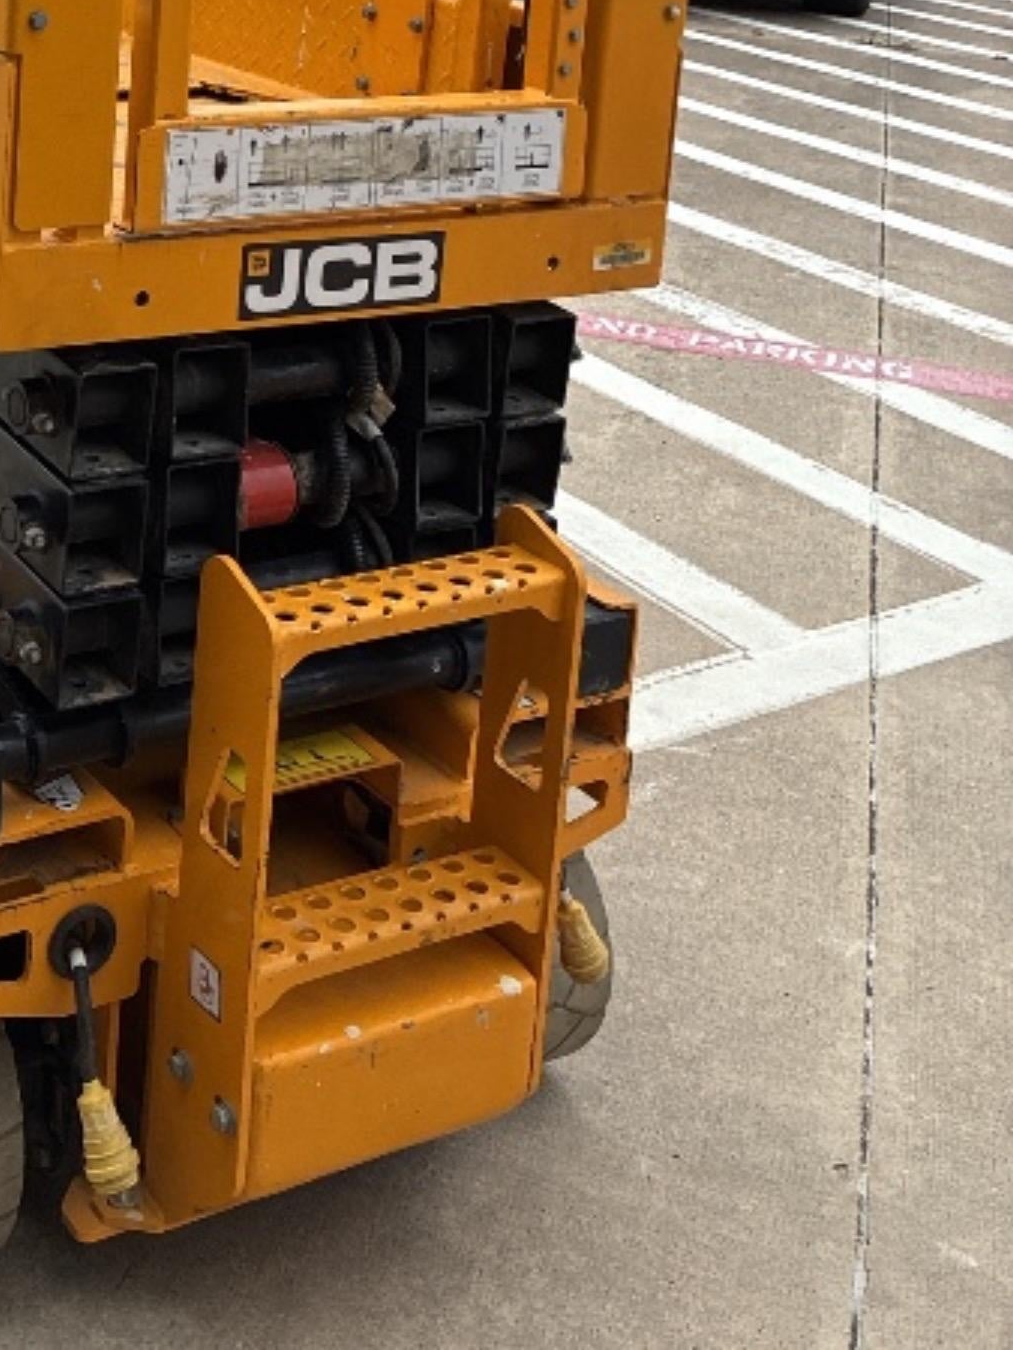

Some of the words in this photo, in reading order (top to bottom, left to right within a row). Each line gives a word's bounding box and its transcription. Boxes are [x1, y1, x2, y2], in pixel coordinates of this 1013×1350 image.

[244, 239, 439, 313] JCB
[592, 317, 658, 338] NO
[688, 332, 913, 379] PARKING
